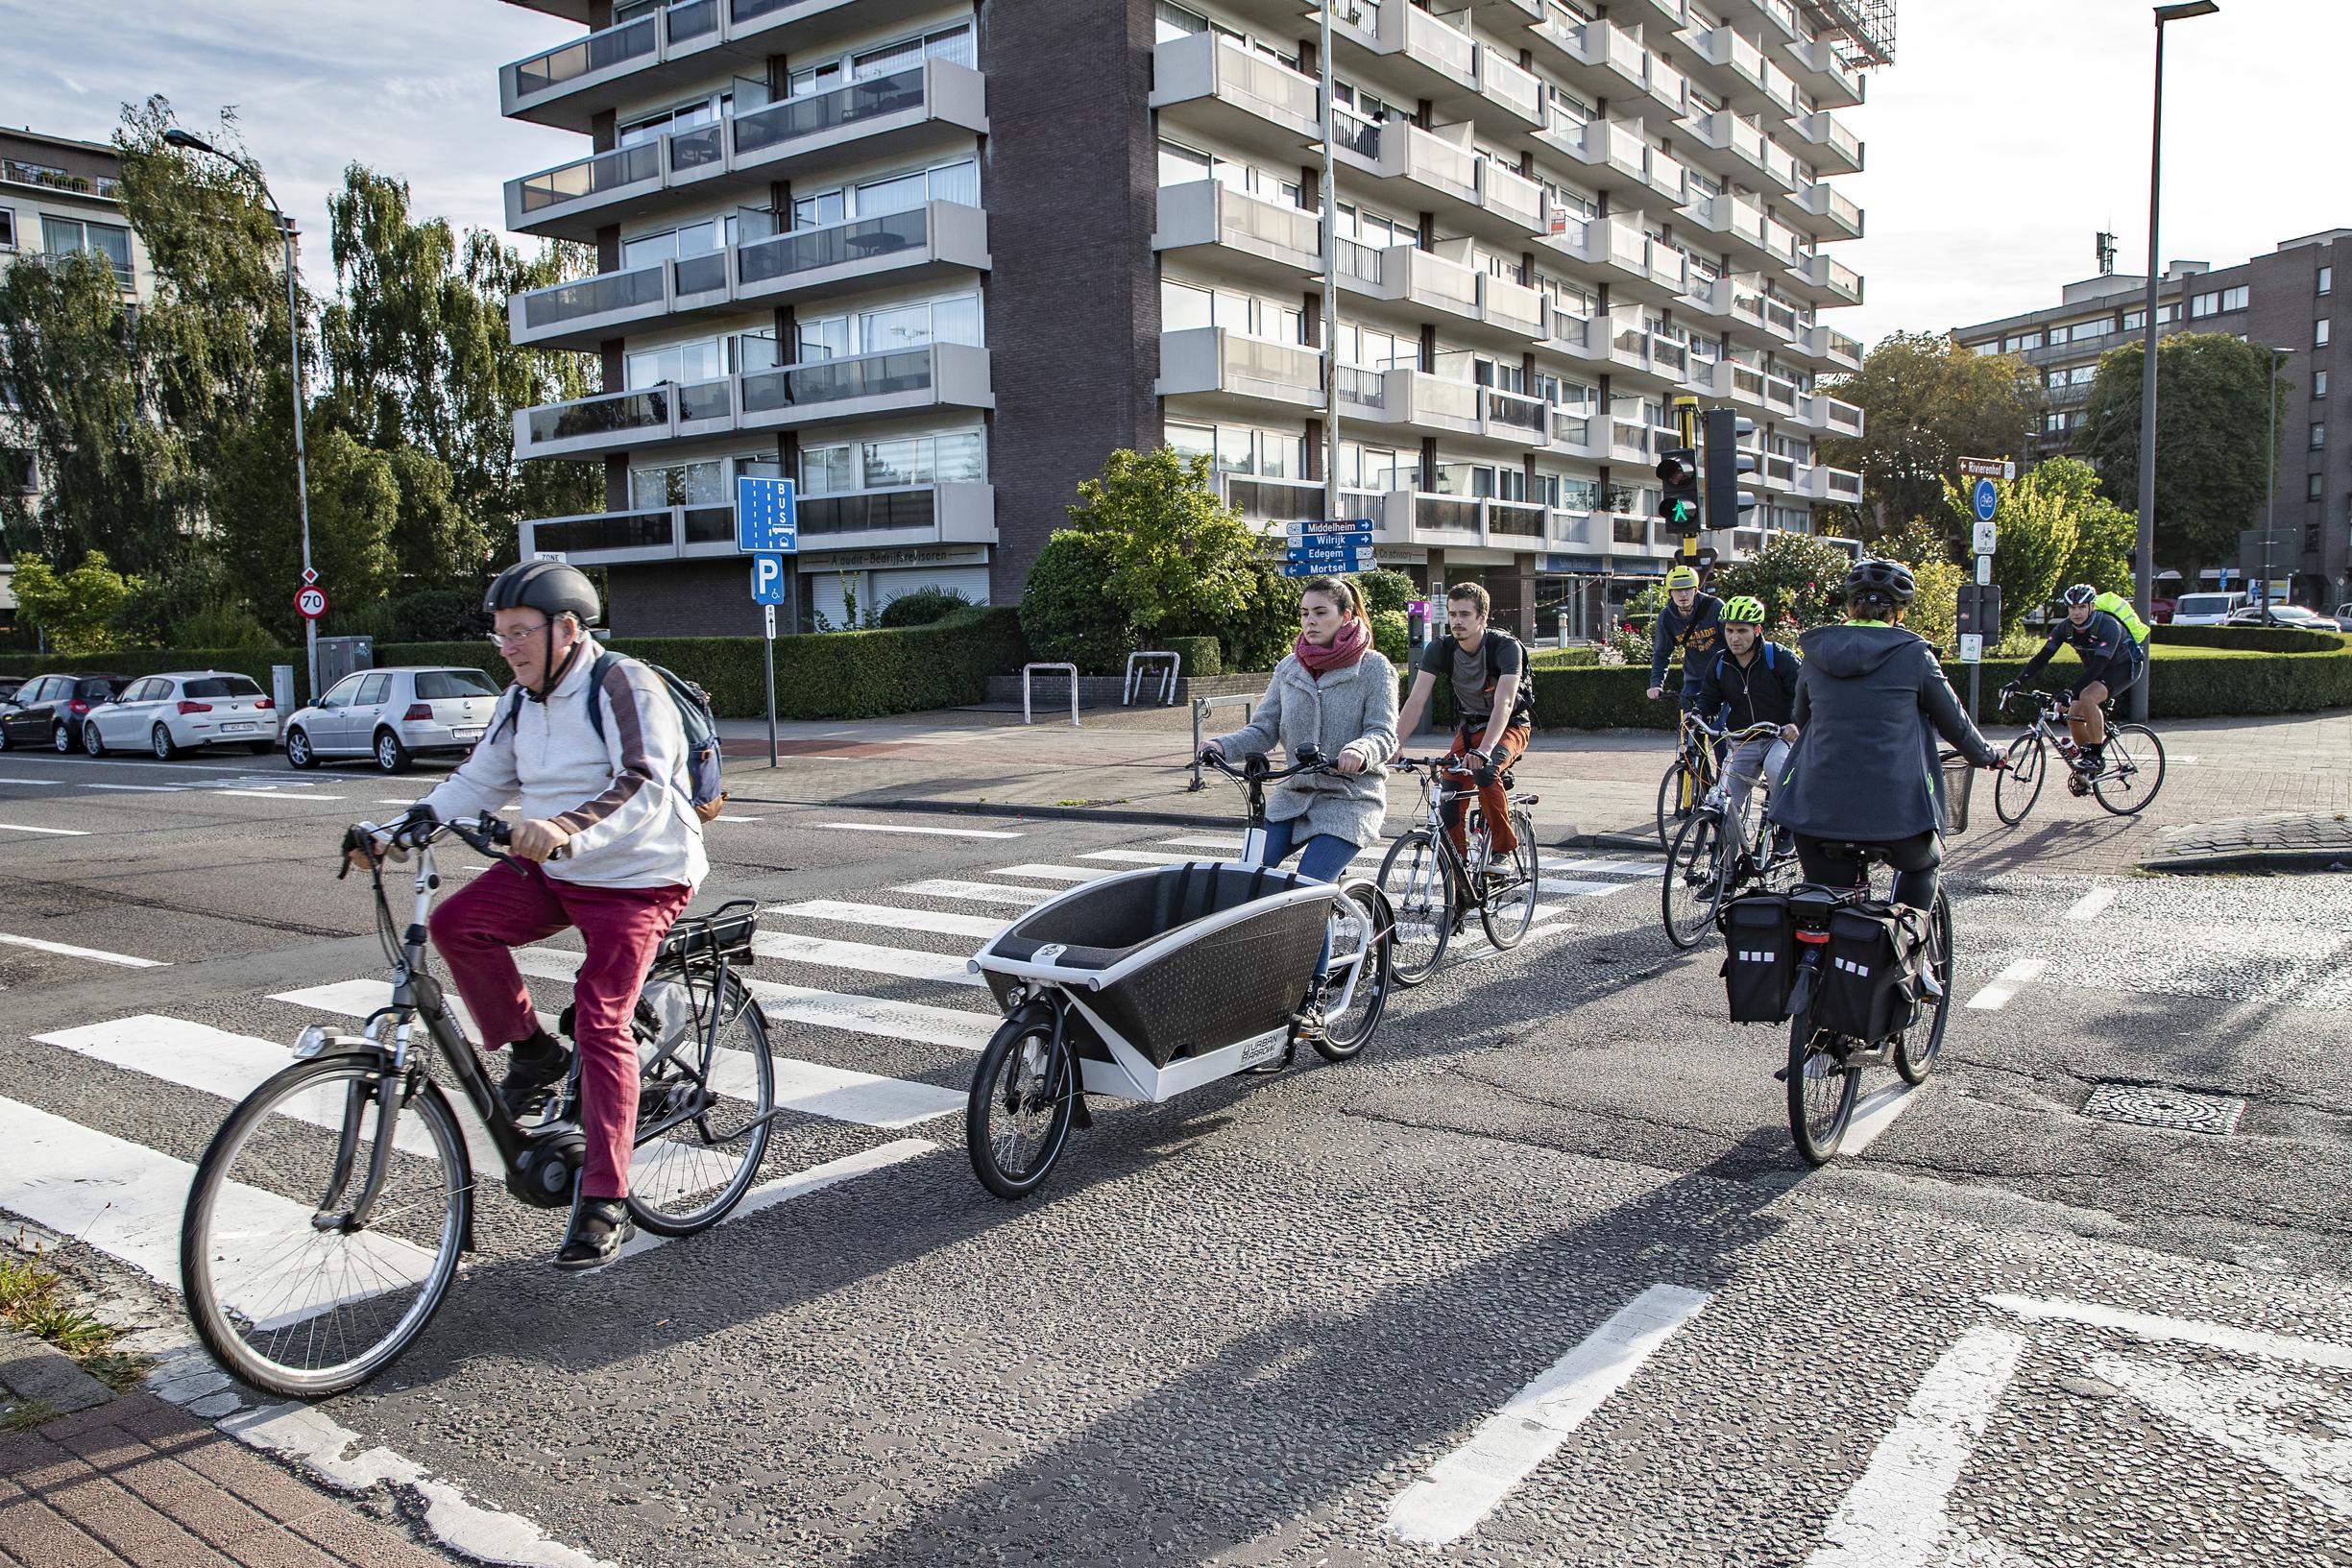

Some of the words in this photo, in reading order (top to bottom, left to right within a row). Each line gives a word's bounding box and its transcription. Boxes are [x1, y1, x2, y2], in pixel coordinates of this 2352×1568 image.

[1969, 461, 2001, 475] Rivierenhof
[778, 483, 787, 523] BUS
[1307, 522, 1356, 533] Middelheim
[1317, 535, 1346, 545] Wilrijk
[1308, 549, 1344, 560] Edegem
[1310, 563, 1346, 574] Mortsel
[759, 559, 778, 594] P
[303, 595, 322, 608] 70
[1408, 603, 1415, 613] P
[1423, 603, 1429, 615] P
[1250, 1034, 1278, 1051] URBAN
